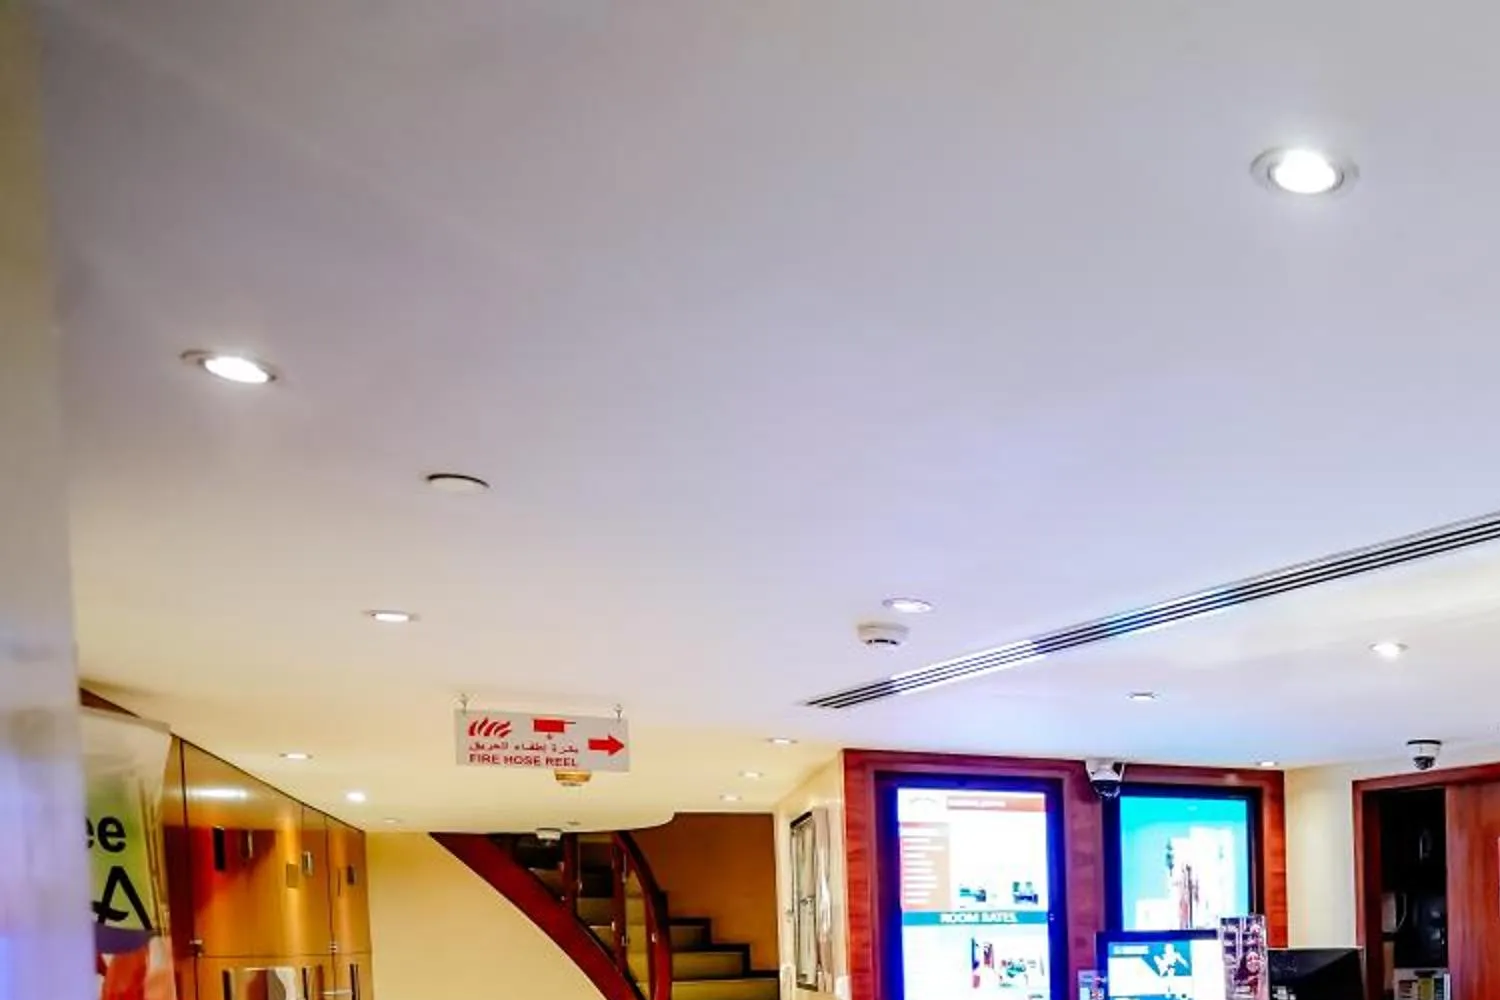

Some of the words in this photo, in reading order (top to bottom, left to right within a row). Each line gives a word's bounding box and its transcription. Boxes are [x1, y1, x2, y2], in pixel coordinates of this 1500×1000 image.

[468, 753, 501, 765] FIRE
[503, 754, 541, 767] HOSE
[544, 756, 580, 768] REEL
[939, 911, 980, 925] ROOM
